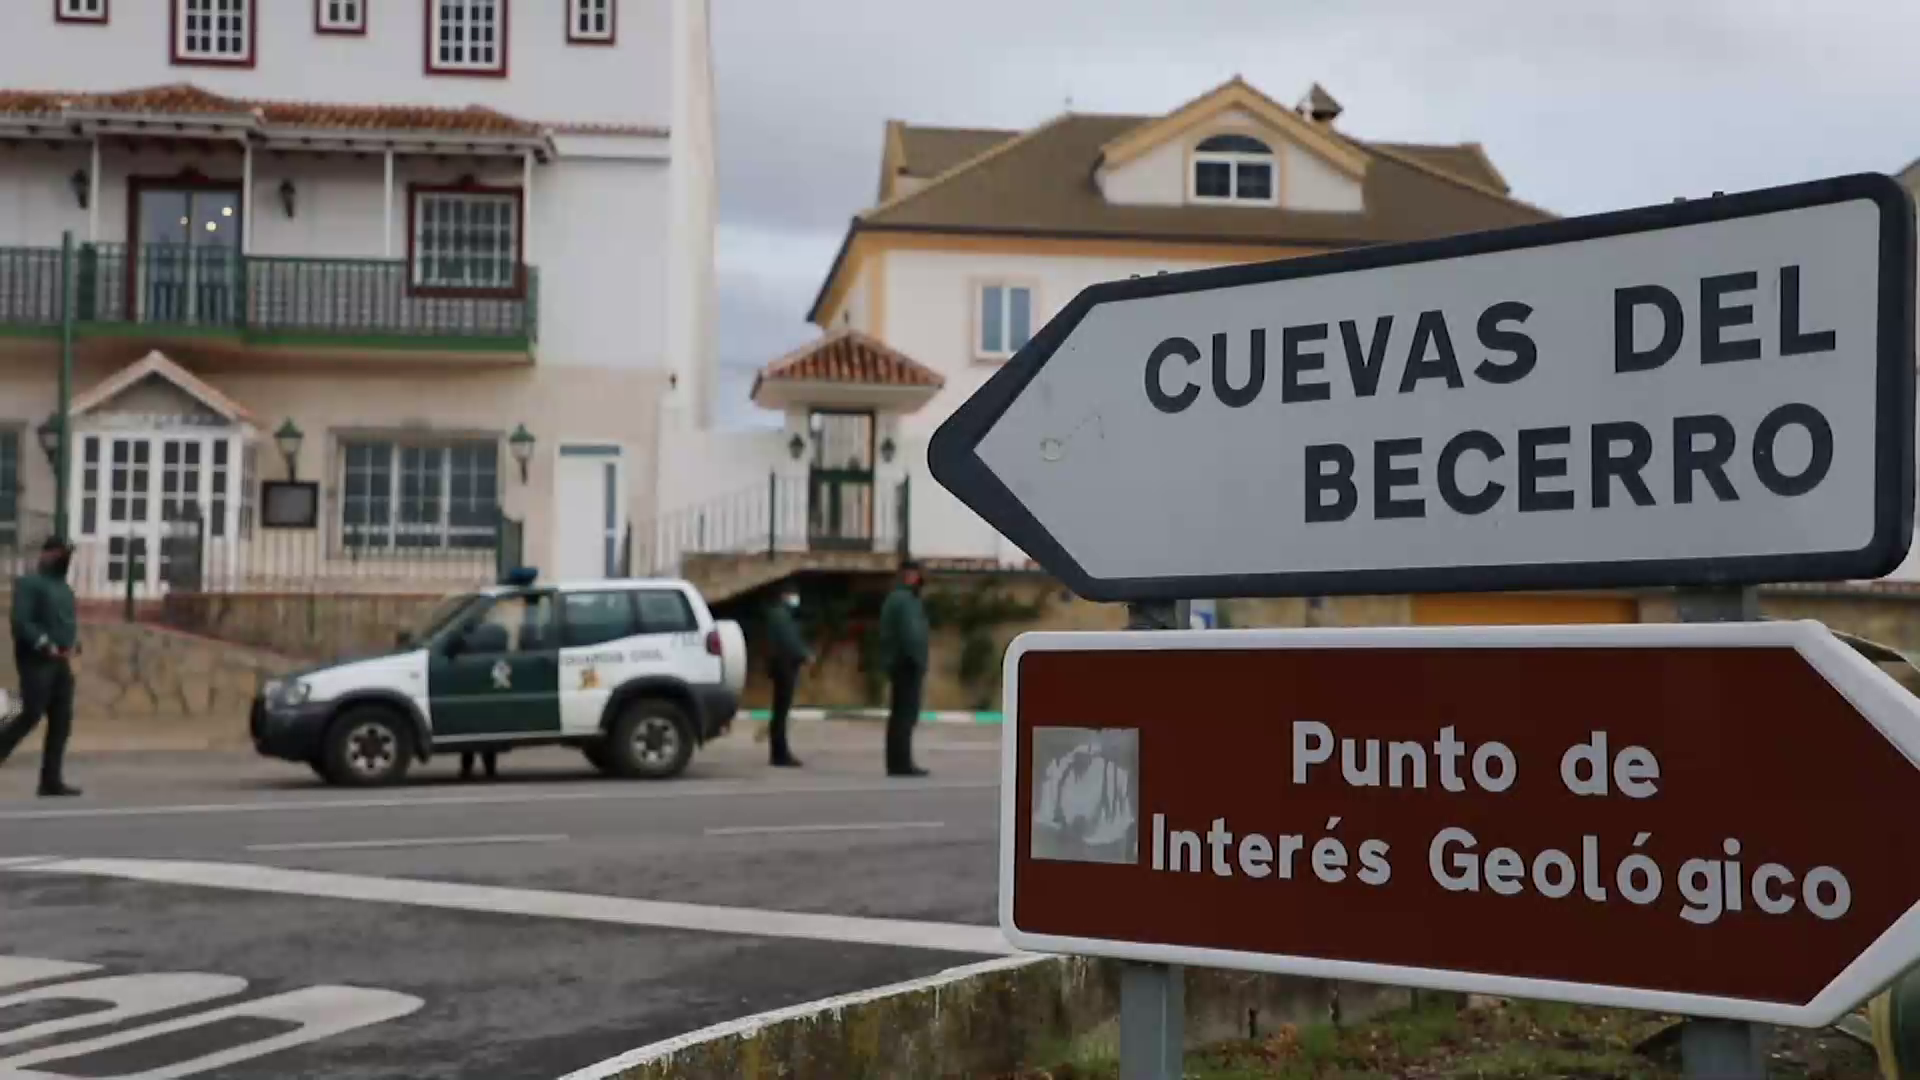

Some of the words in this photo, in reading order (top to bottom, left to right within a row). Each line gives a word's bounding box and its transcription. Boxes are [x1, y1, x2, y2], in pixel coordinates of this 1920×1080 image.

[1144, 300, 1538, 415] CUEVAS
[1613, 264, 1838, 375] DEL
[1303, 402, 1835, 524] BECERRO
[1292, 720, 1517, 792] Punto
[1560, 731, 1660, 798] de
[1151, 813, 1392, 885] Interés
[1428, 826, 1852, 925] Geológico
